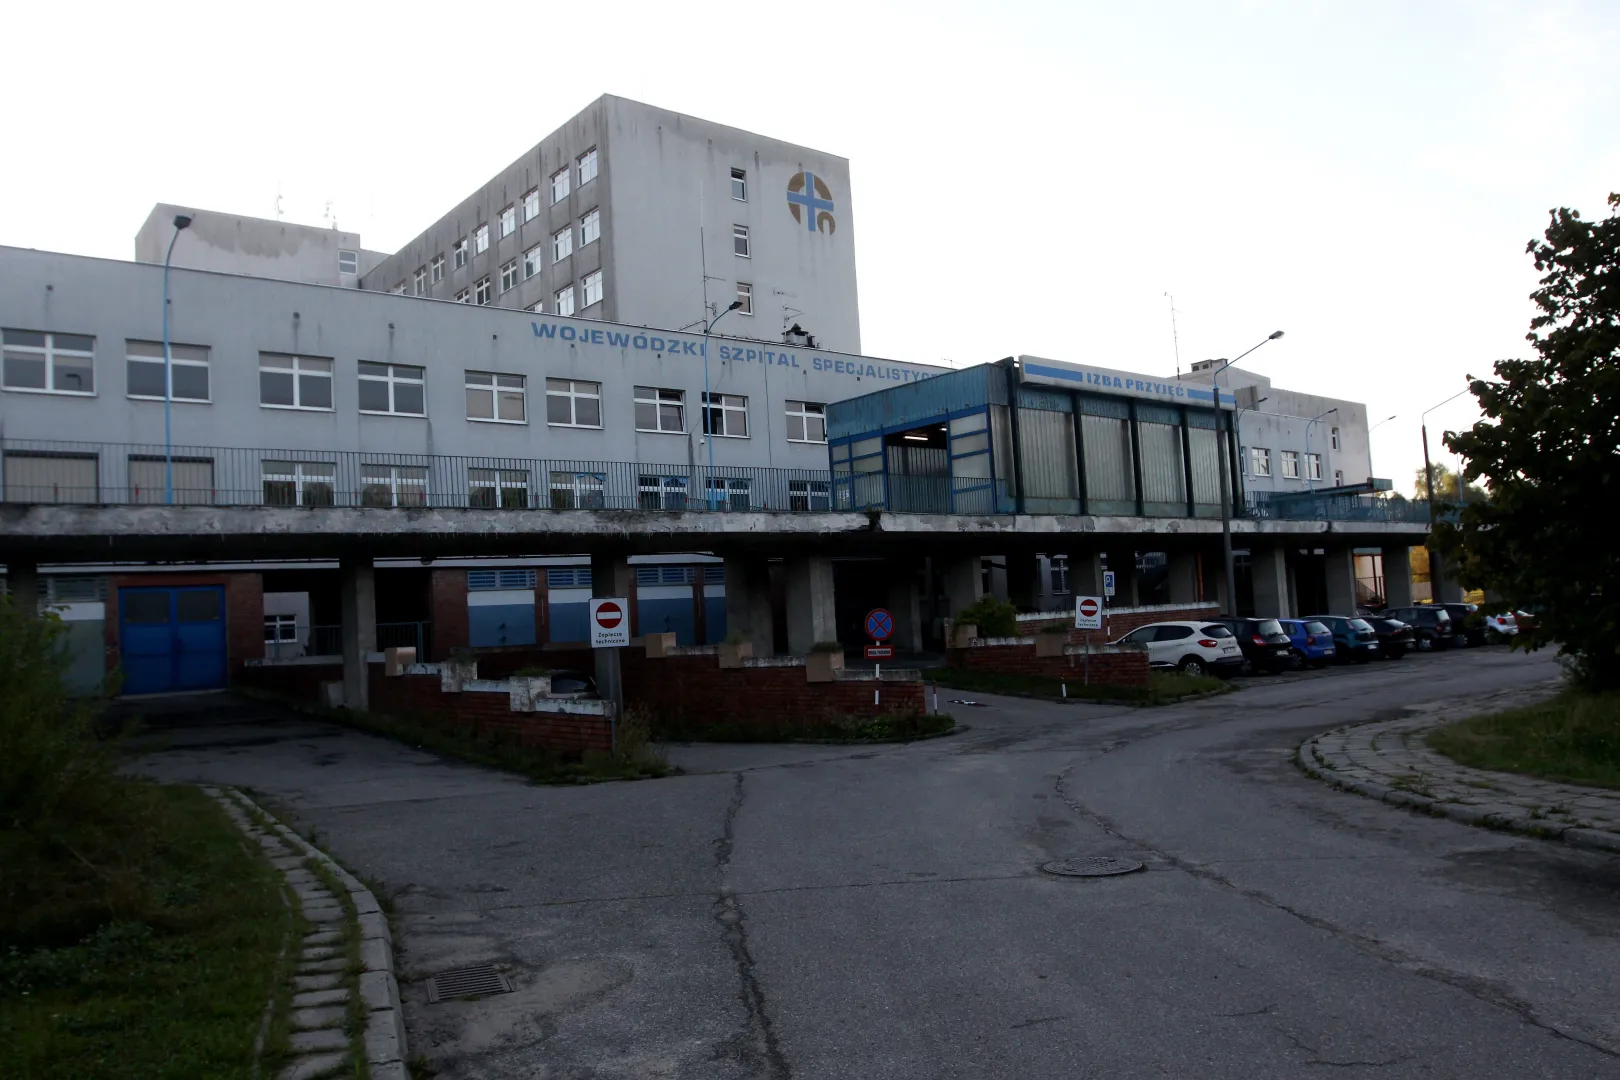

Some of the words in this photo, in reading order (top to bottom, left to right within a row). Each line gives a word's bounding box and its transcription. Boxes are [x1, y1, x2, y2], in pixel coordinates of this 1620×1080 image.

[531, 322, 705, 357] WOJEWÓDZKI
[720, 345, 800, 368] SZPITAL
[1087, 372, 1122, 389] IZBA
[1126, 378, 1184, 397] PRZYJĘĆ
